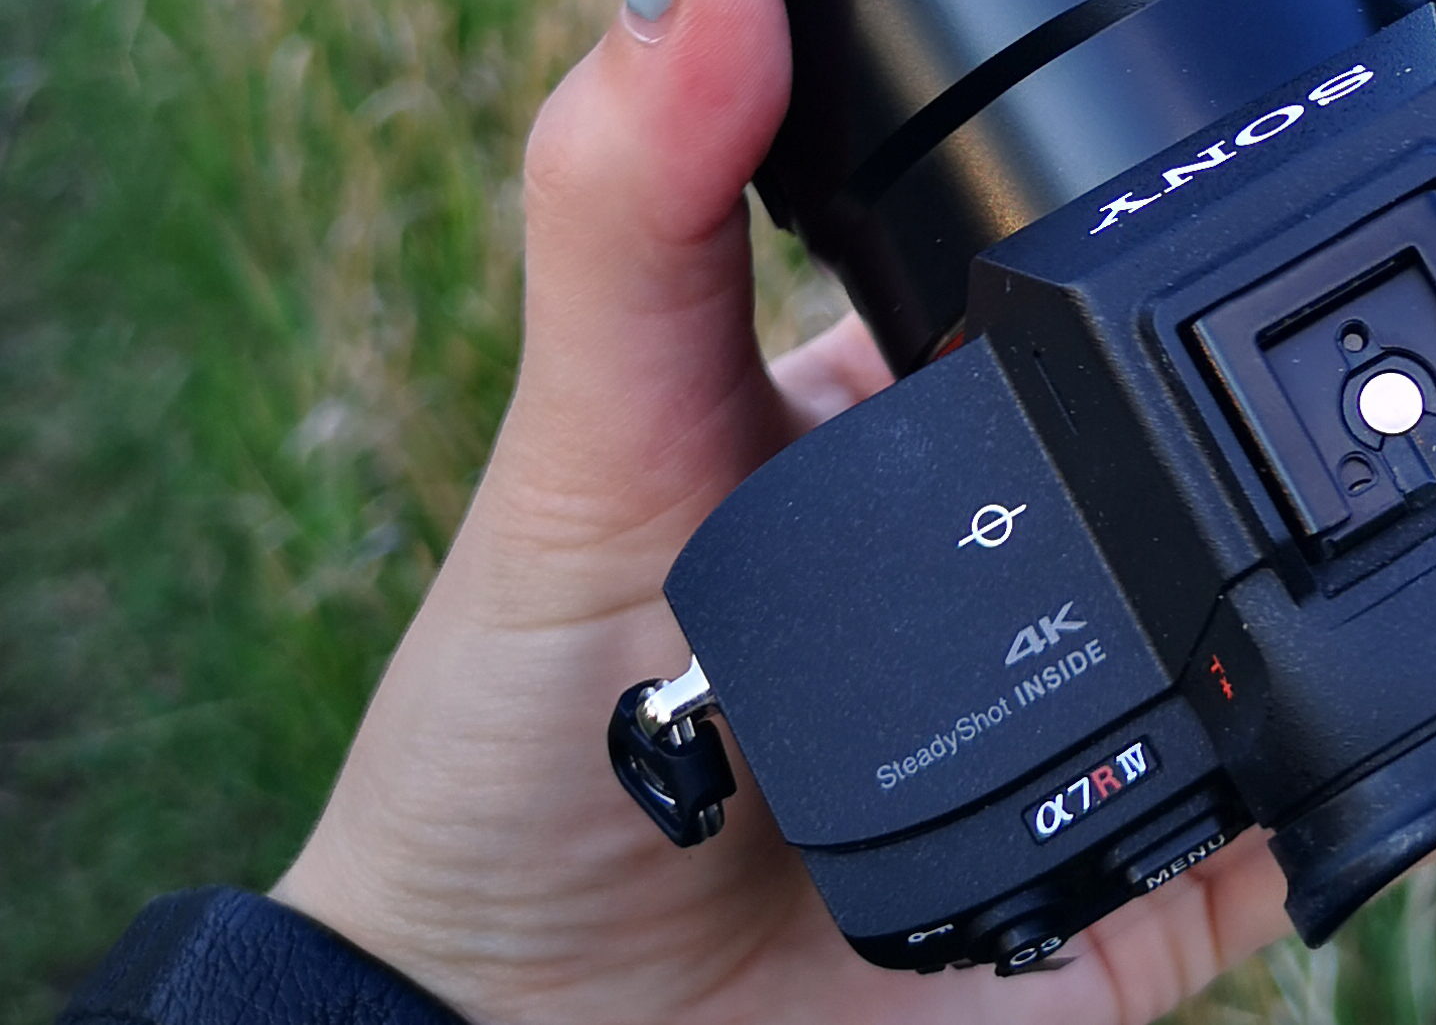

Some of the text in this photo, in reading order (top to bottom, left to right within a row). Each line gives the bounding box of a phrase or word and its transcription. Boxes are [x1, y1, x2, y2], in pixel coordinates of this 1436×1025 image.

[1090, 64, 1374, 235] SONY
[1005, 601, 1088, 665] 4K
[876, 638, 1107, 789] SteadyShot INSIDE
[1146, 834, 1225, 890] MENU
[1009, 936, 1062, 968] C3
